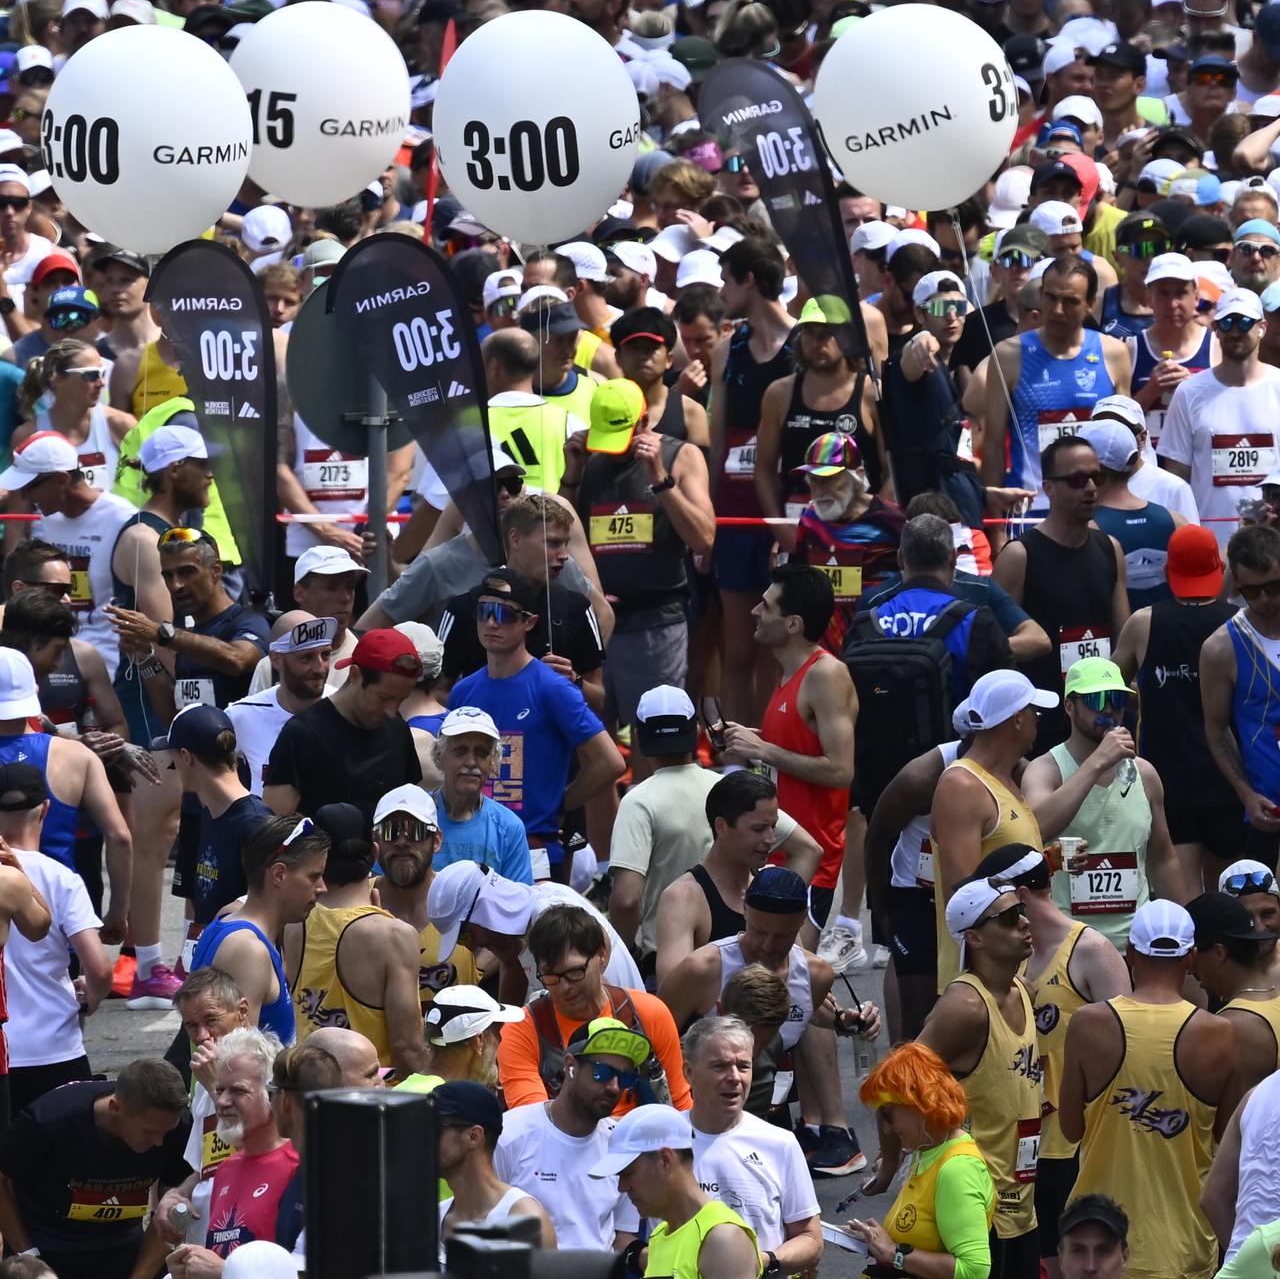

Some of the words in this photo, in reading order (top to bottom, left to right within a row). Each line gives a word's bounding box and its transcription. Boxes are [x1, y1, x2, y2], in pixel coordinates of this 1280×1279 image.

[319, 116, 407, 139] GARMIN
[844, 104, 953, 154] GARMIN
[41, 114, 120, 187] 3:00
[153, 140, 248, 165] GARMIN
[463, 116, 581, 192] 3:00
[1229, 450, 1259, 468] 2819
[320, 465, 350, 483] 2173
[608, 516, 634, 535] 475
[297, 620, 326, 645] Buff
[1077, 641, 1101, 660] 956
[181, 680, 200, 701] 1405
[1087, 872, 1122, 894] 1272
[213, 1228, 241, 1244] FINISHER
